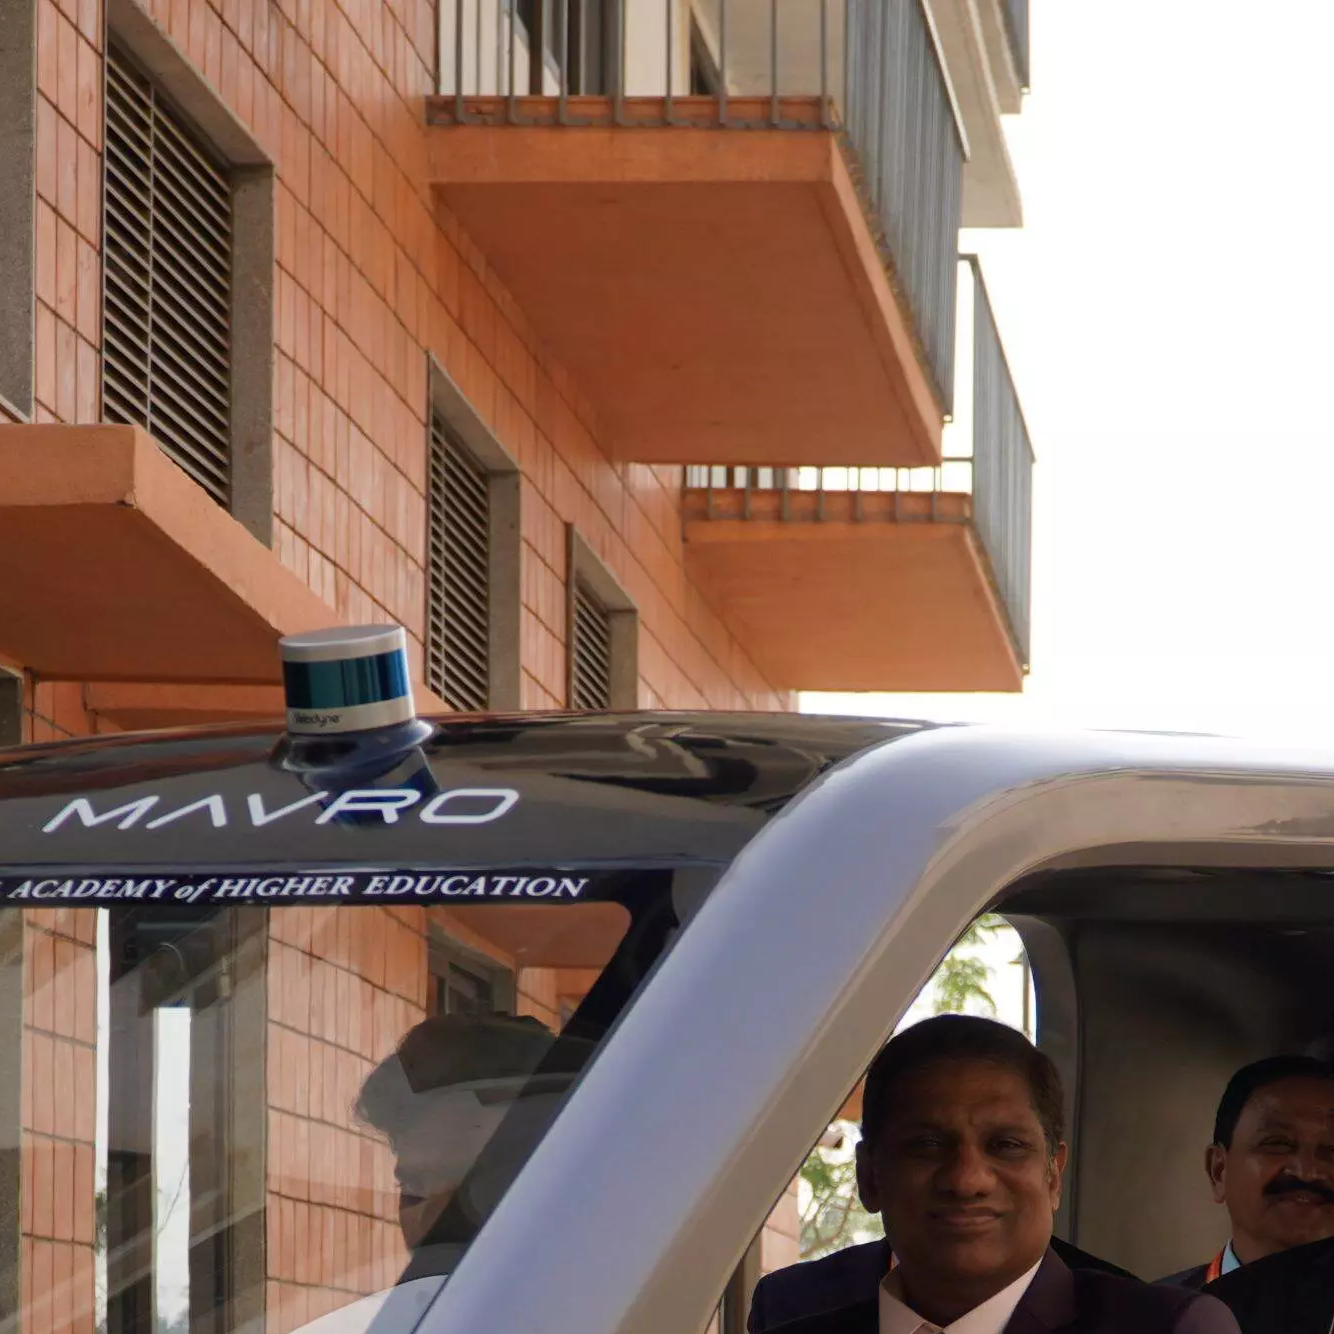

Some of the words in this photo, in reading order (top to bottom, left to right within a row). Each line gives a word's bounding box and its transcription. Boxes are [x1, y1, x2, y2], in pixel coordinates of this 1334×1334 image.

[42, 788, 520, 834] MAVRO
[8, 879, 178, 900] ACADEMY
[174, 878, 218, 904] of
[215, 876, 355, 898] HIGHER
[362, 875, 590, 898] EDUCATION
